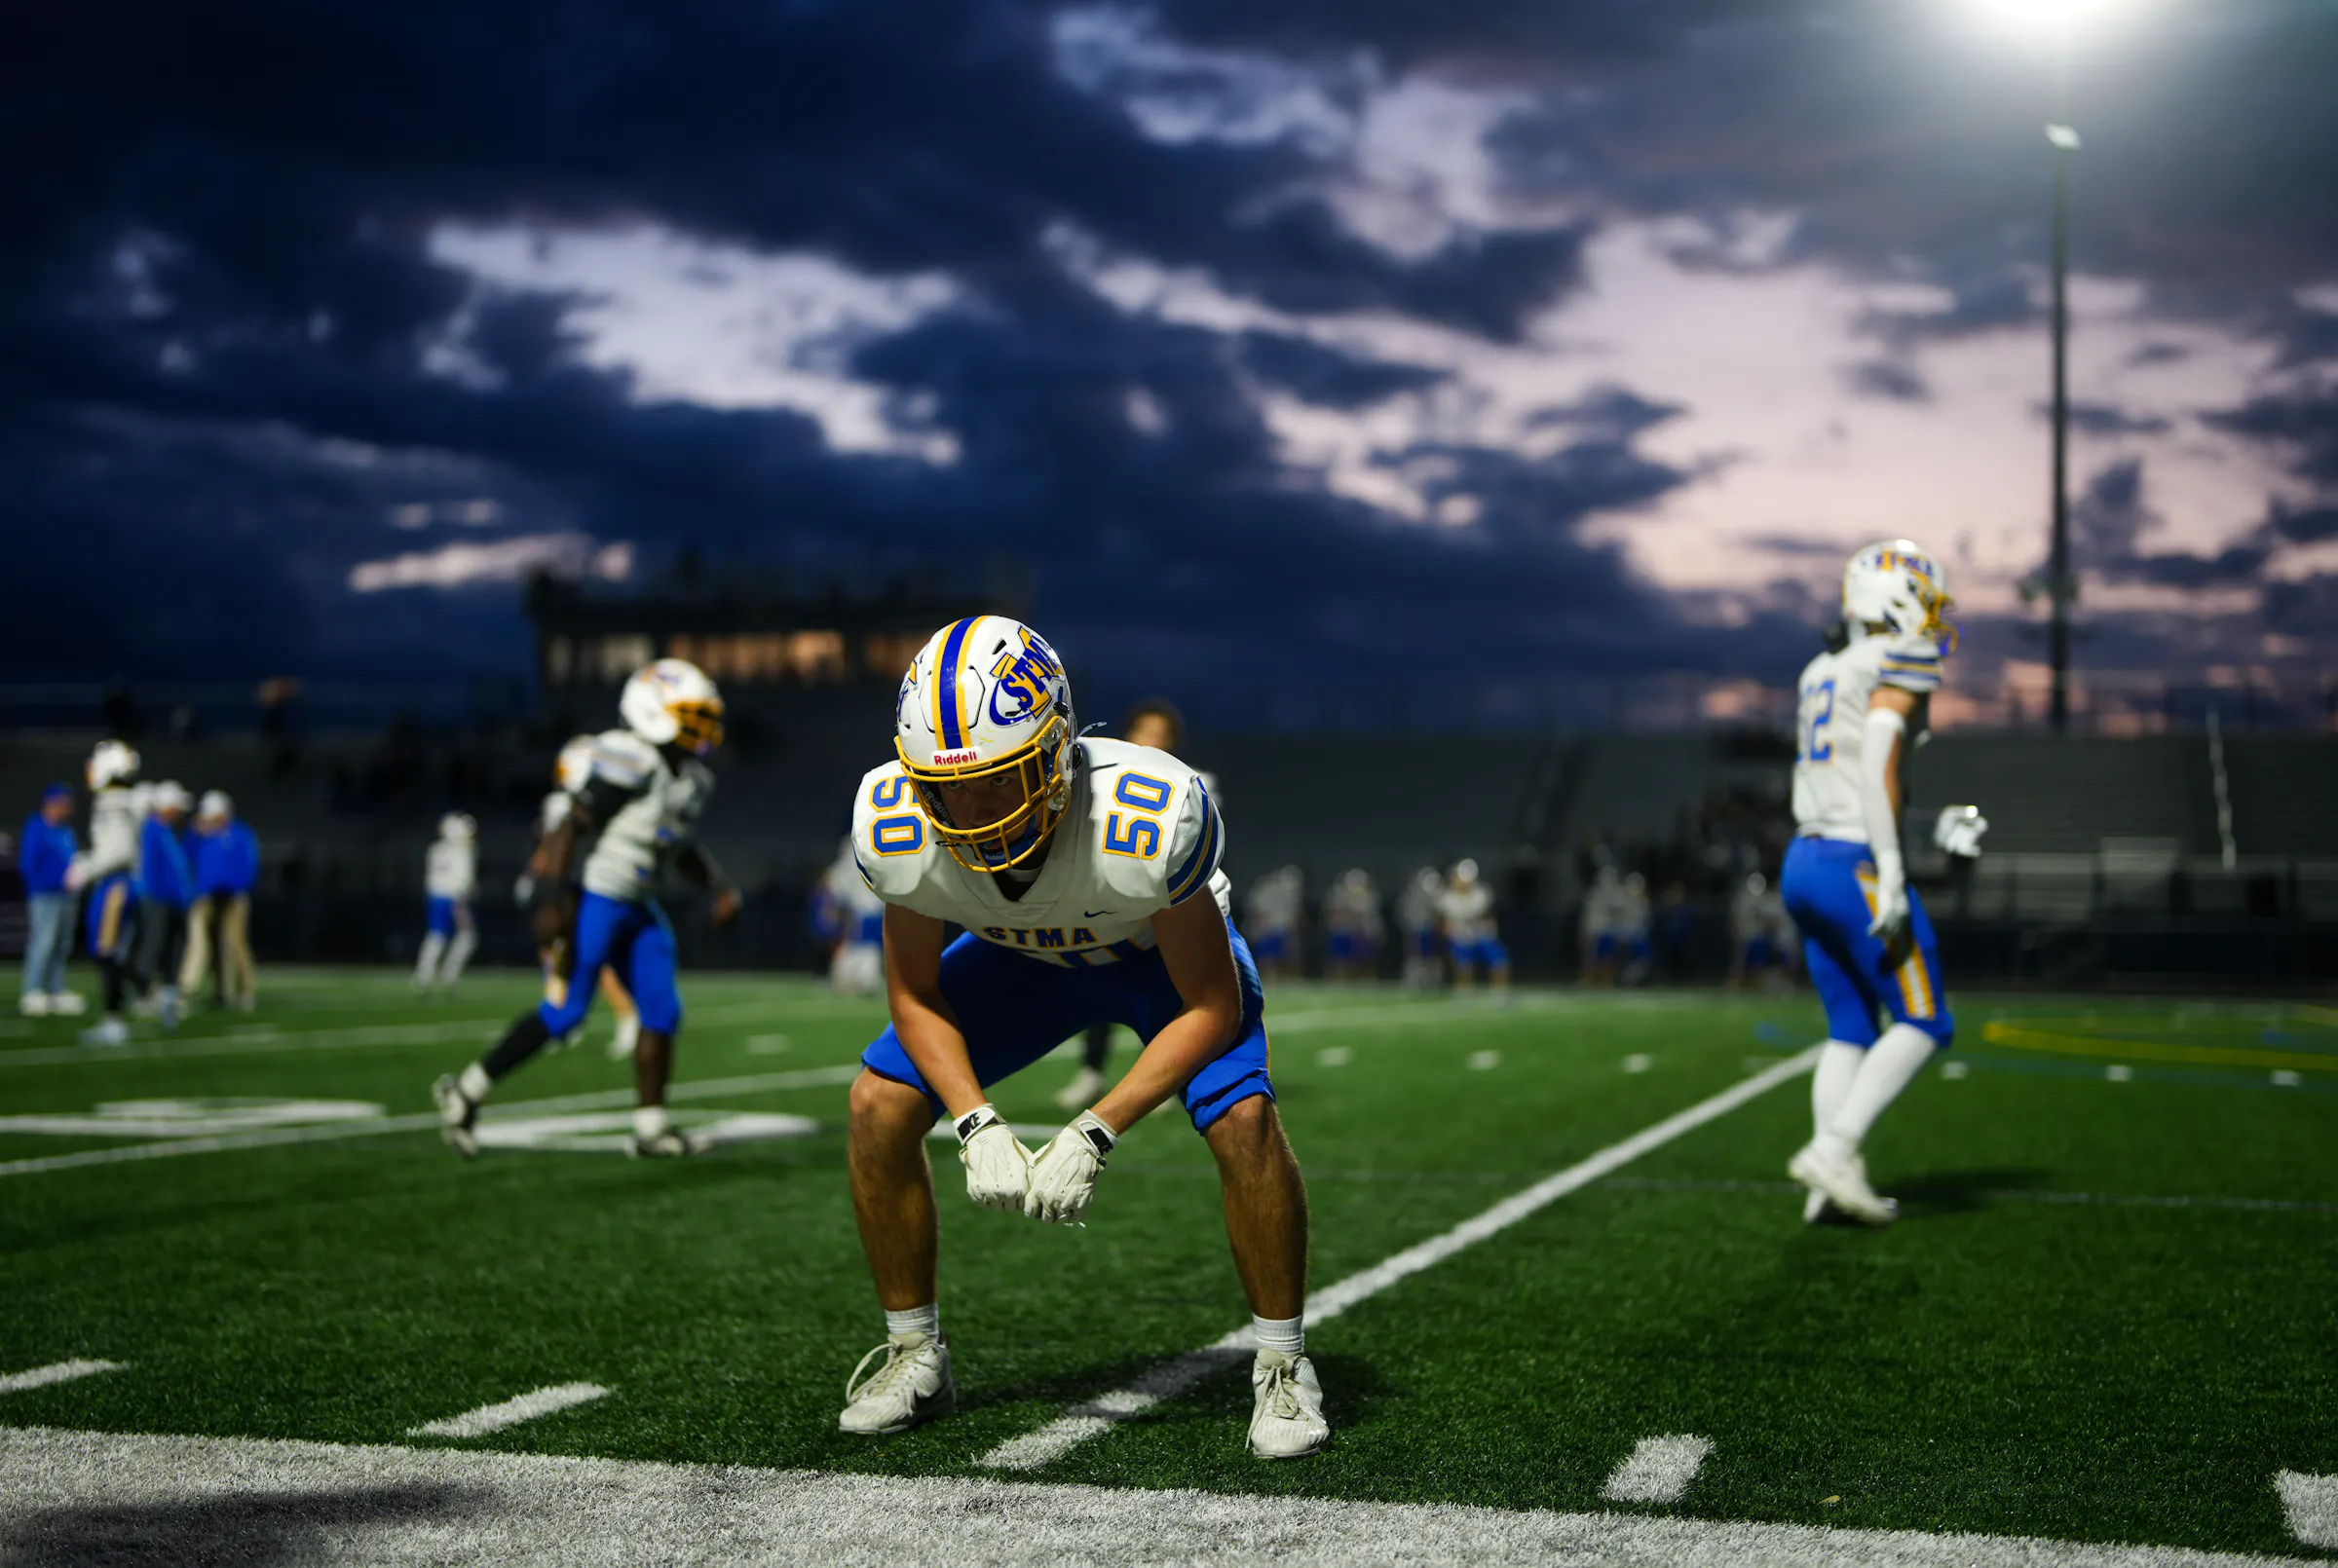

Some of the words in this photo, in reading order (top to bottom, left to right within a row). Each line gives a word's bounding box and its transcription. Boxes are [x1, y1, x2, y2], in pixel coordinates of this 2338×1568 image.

[933, 751, 977, 765] Riddell
[869, 776, 926, 857] 50
[1102, 770, 1175, 861] 50
[982, 926, 1099, 949] STMA
